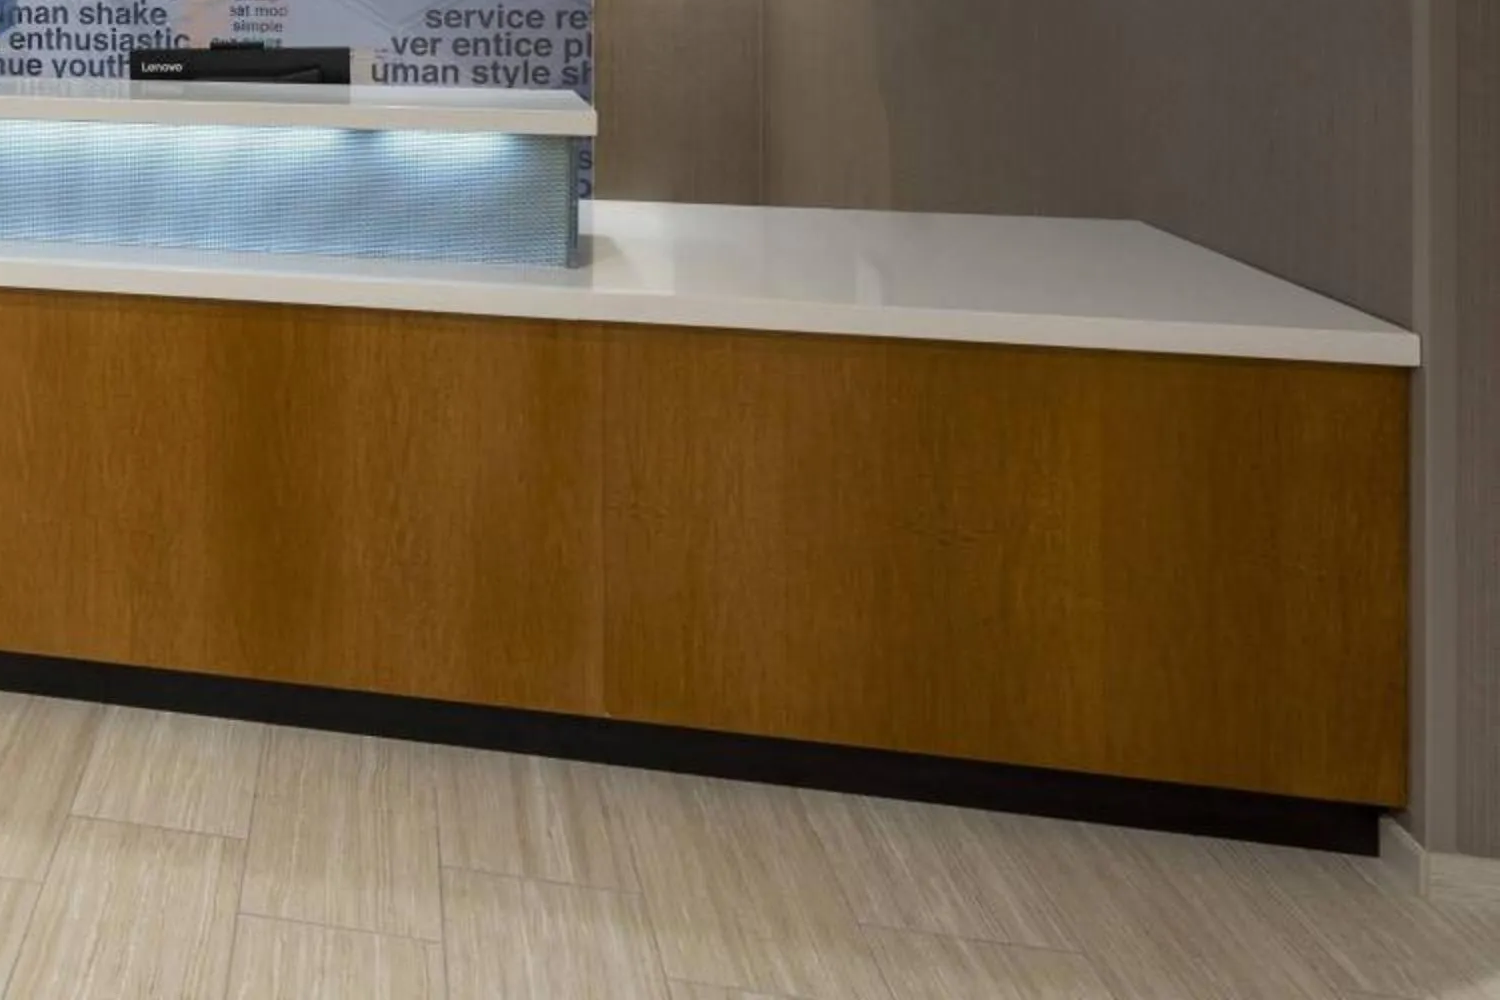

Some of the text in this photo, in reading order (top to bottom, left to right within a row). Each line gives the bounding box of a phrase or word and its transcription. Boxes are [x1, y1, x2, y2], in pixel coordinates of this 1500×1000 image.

[78, 2, 168, 25] shake
[425, 3, 545, 29] service
[9, 27, 191, 50] enthusiastic
[391, 35, 442, 56] ver
[452, 32, 553, 57] entice
[141, 61, 184, 73] Lenovo
[371, 61, 460, 84] uman
[471, 60, 551, 88] style
